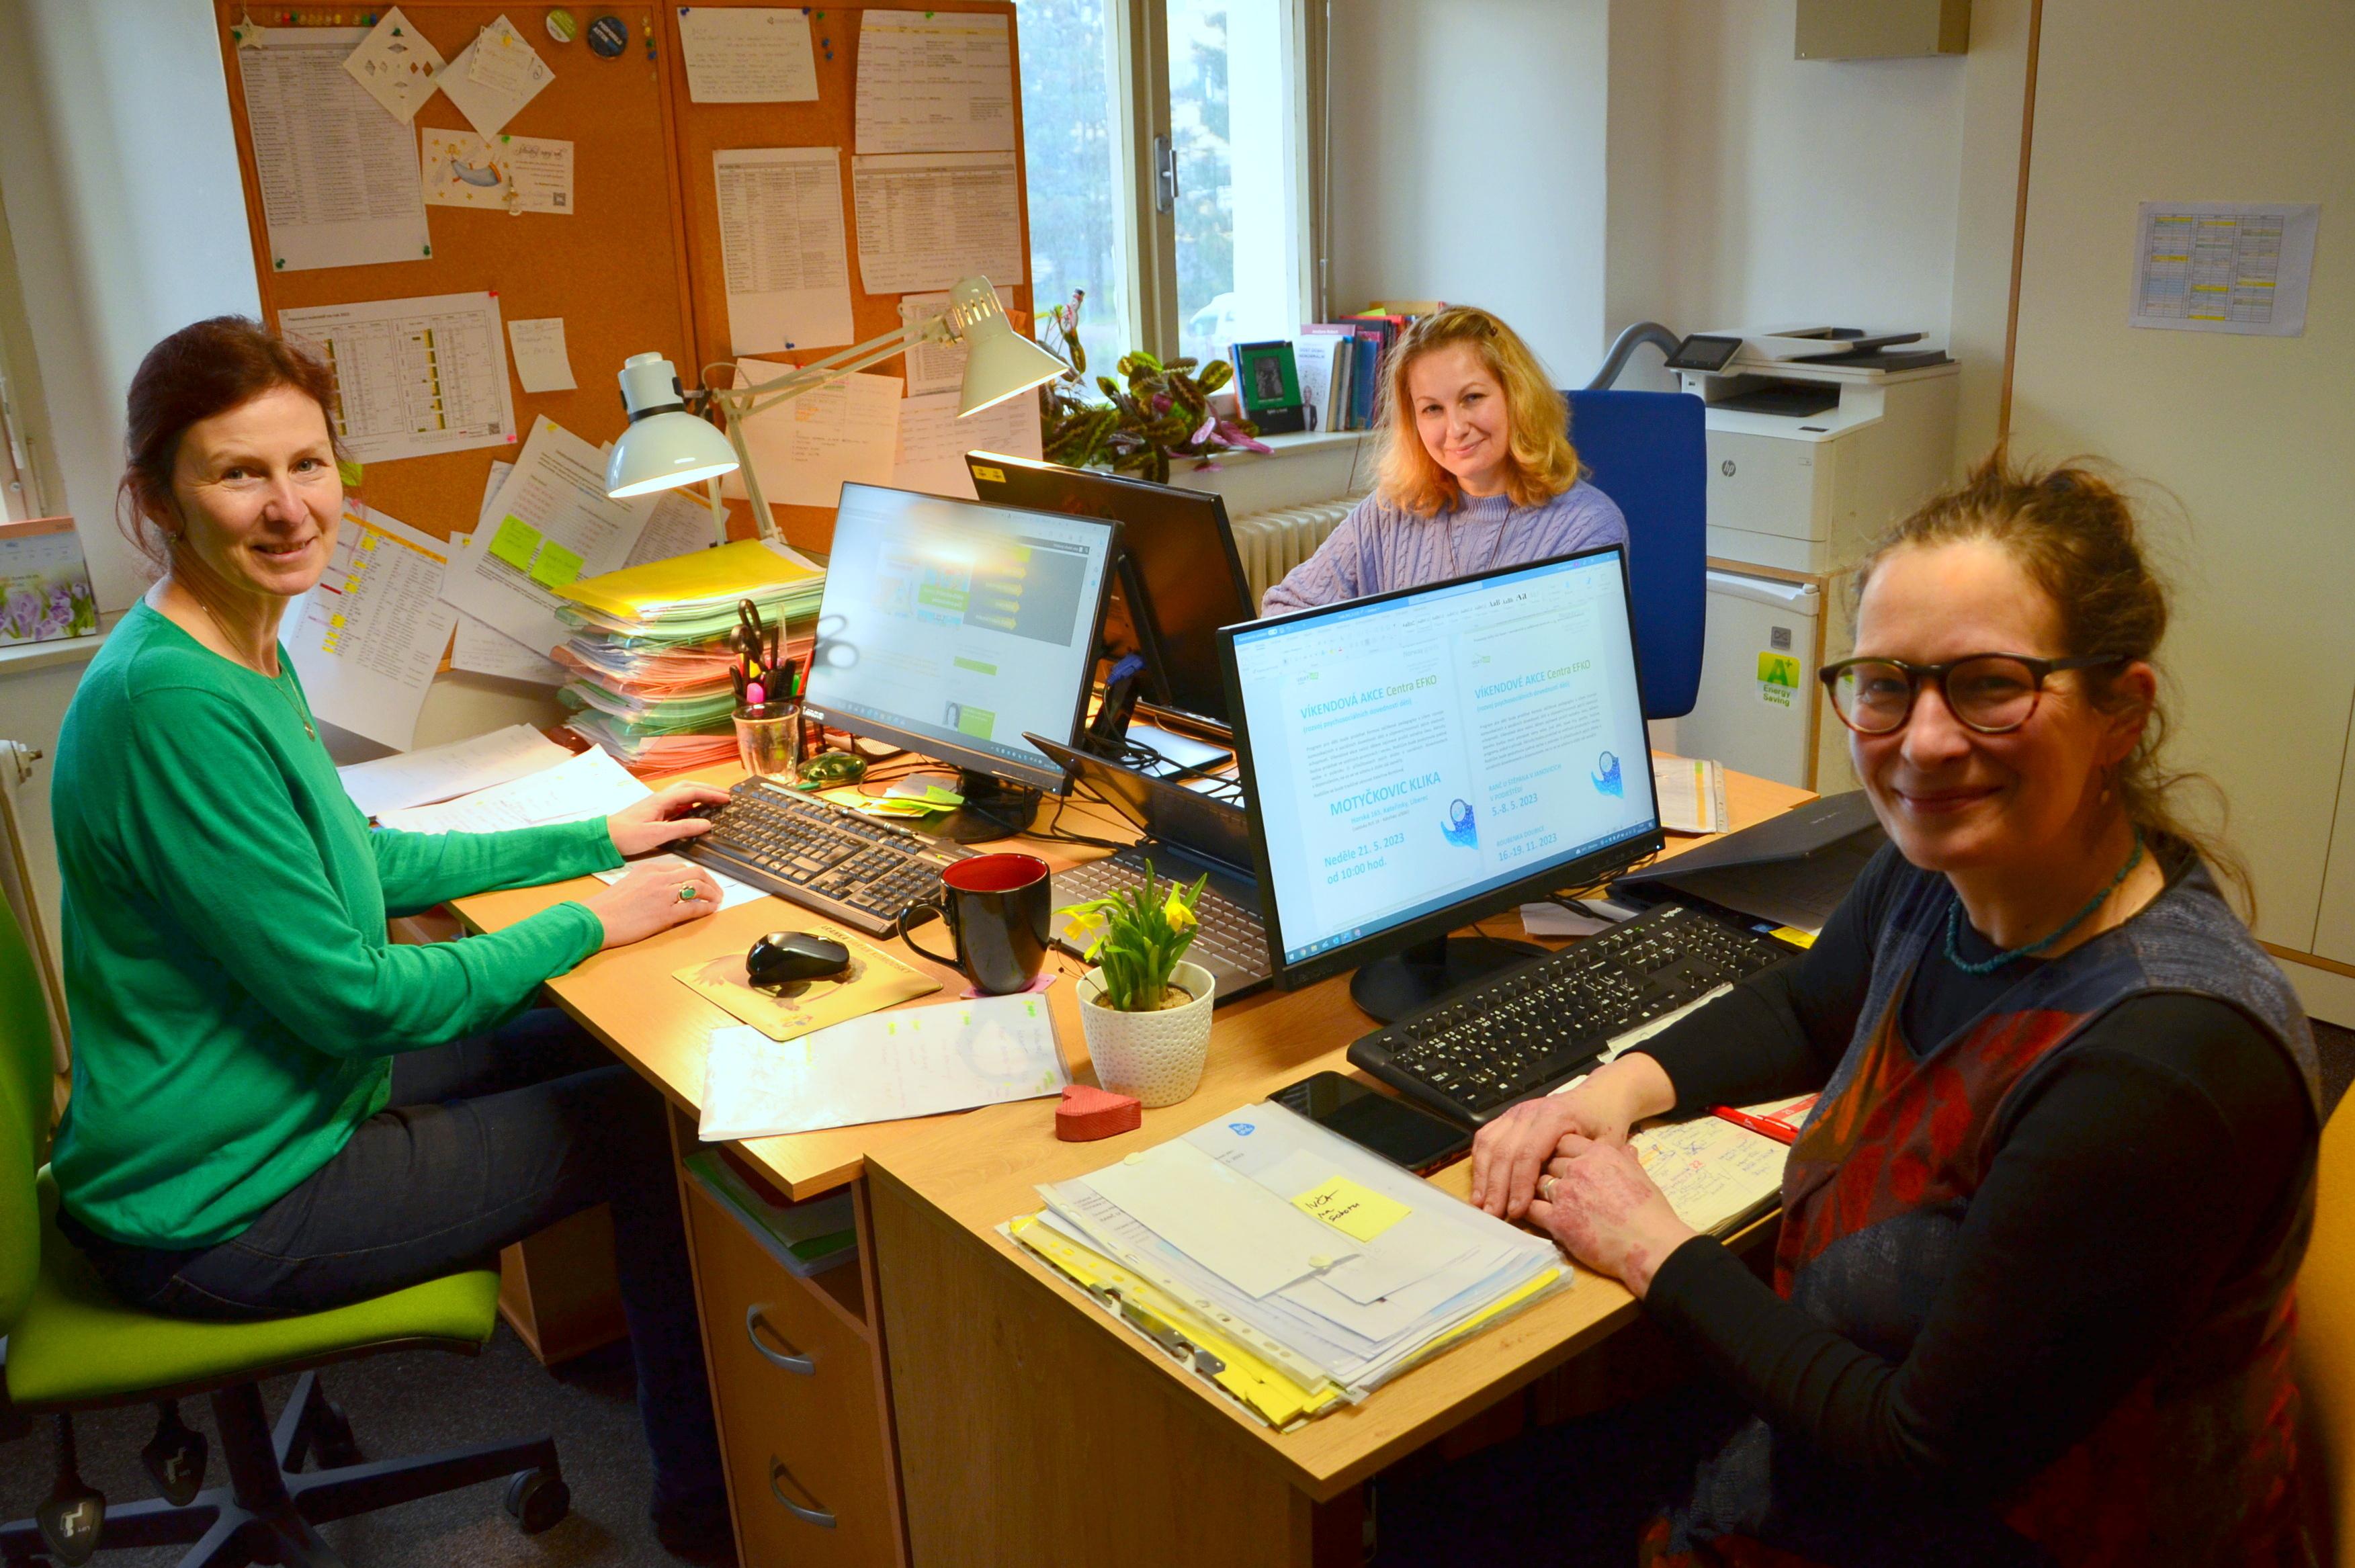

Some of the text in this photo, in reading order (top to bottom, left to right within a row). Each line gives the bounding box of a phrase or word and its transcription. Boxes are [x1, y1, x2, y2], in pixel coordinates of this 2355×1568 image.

[1474, 659, 1591, 699] VÍKENDOVÉ AKCE Centra EFKO
[1763, 684, 1791, 698] Energy
[1301, 674, 1437, 719] VÍKENDOVÁ AKCE Centra EFKO
[1763, 693, 1790, 707] Saving
[802, 705, 824, 720] Lenovo
[1330, 771, 1441, 816] MOTYČKOVIC KLIKA
[1492, 793, 1538, 816] 5.-8. 5. 2023
[1324, 832, 1405, 867] Neděle 21. 5. 2023
[1499, 832, 1557, 861] 16.-19. 11. 2023
[1327, 857, 1387, 884] od 10:00 hod.
